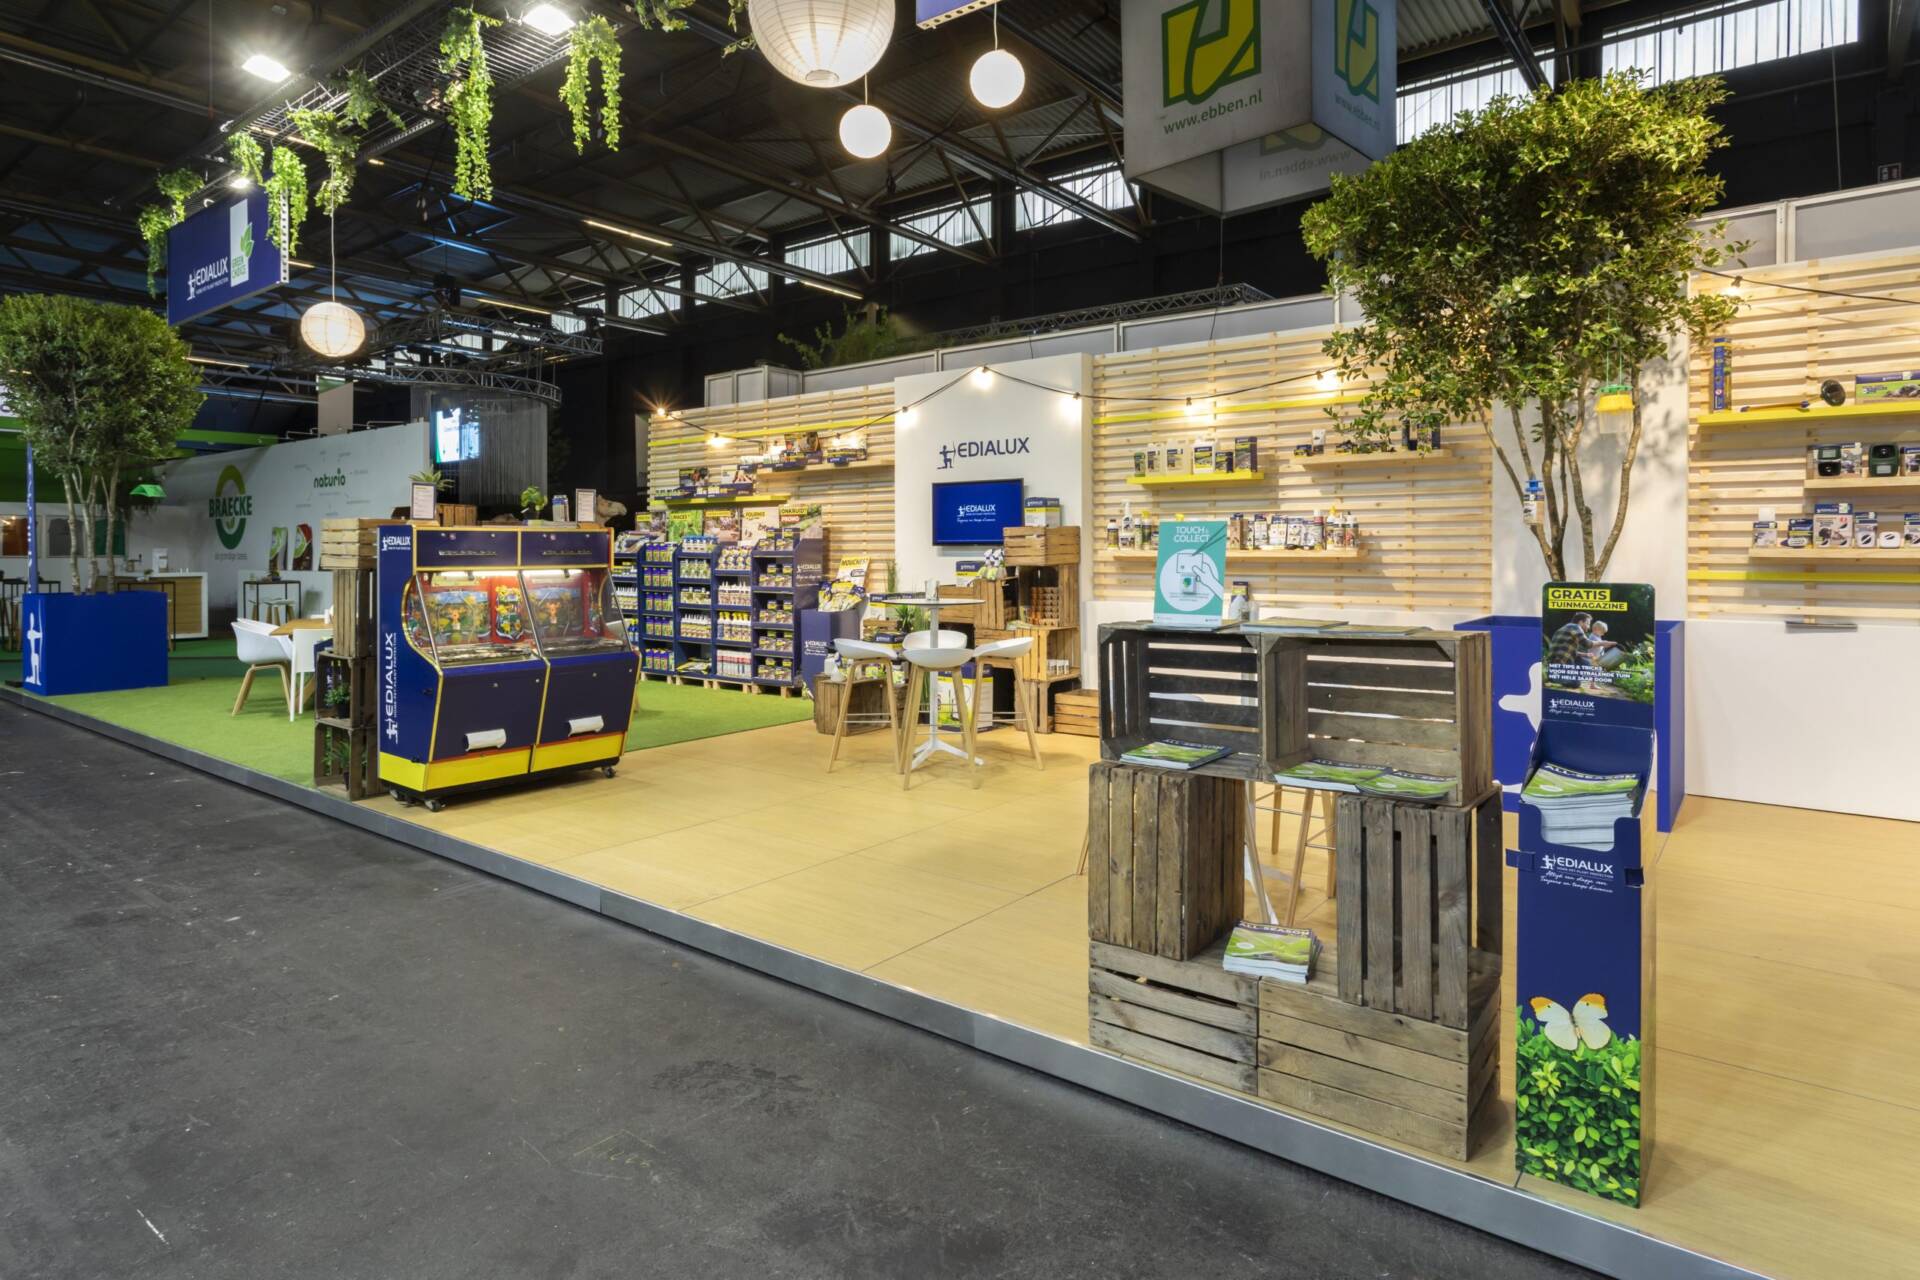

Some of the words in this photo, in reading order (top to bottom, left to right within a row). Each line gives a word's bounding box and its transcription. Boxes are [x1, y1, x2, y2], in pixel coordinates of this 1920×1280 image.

[1163, 89, 1263, 135] www.ebben.nl
[195, 256, 229, 287] EDIALUX
[957, 437, 1030, 458] EDIALUX
[313, 467, 346, 488] naturio
[208, 496, 253, 518] BRAECKE
[965, 504, 996, 513] EDIALUX
[1175, 526, 1205, 534] TOUCH
[388, 536, 411, 545] EDIALUX
[1173, 534, 1210, 543] COLLECT
[1551, 589, 1608, 601] GRATIS
[1551, 601, 1625, 610] TUINMAGAZINE
[385, 632, 393, 717] EDIALUX
[1560, 699, 1595, 708] EDIALUX
[1557, 857, 1613, 874] EDIALUX
